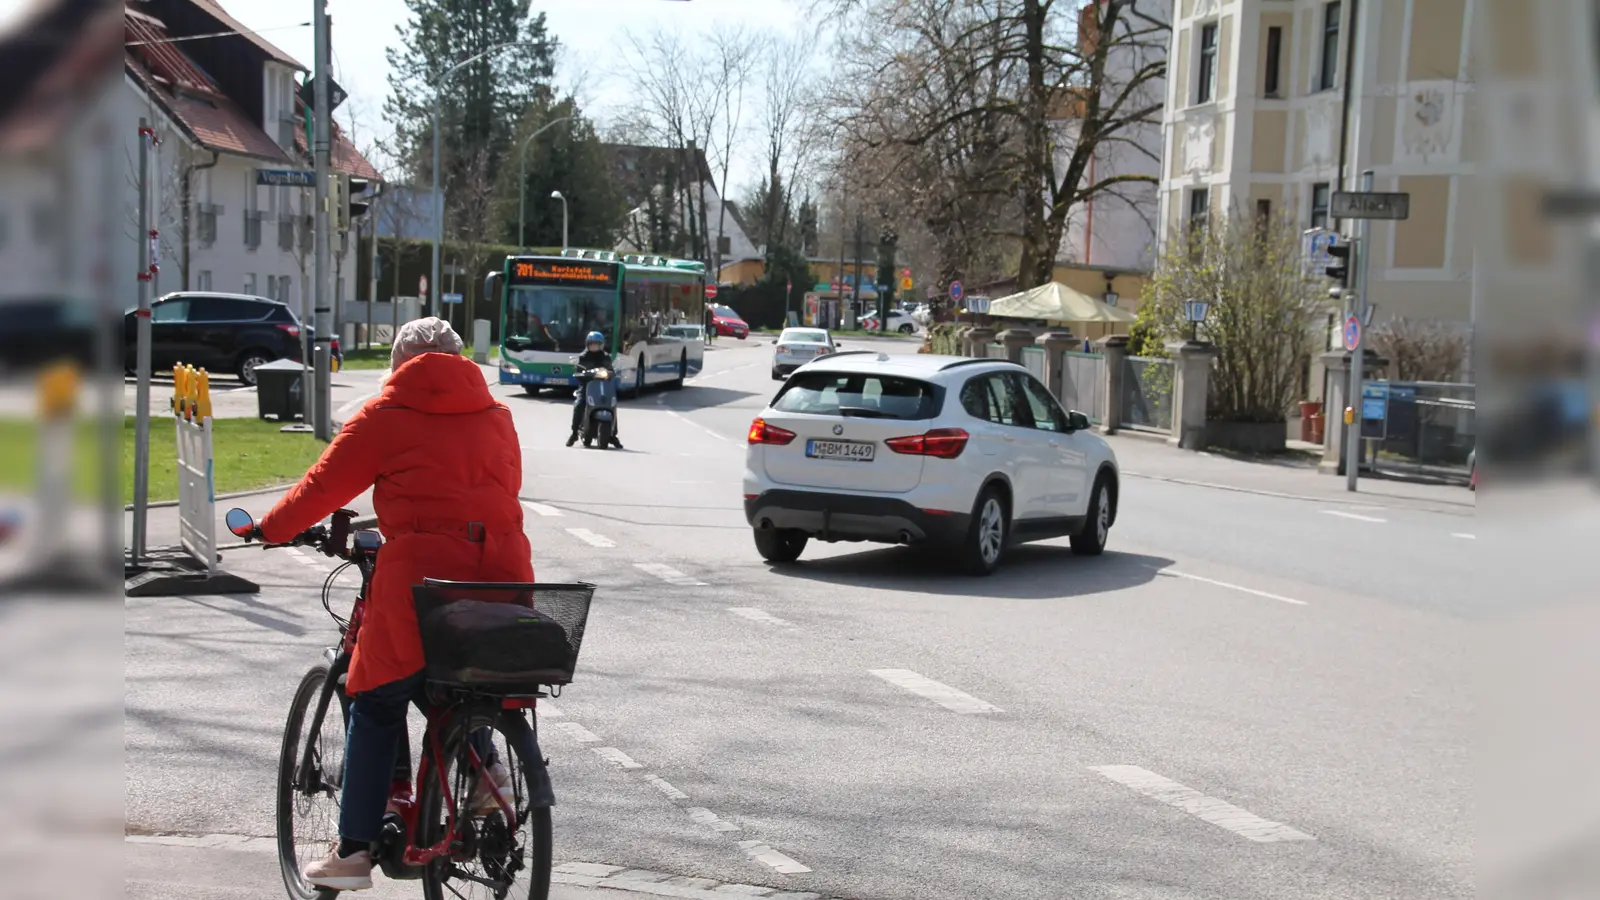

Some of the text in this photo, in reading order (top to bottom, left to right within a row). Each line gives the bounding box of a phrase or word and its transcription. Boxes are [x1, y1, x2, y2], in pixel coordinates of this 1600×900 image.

[1348, 195, 1393, 212] Allach
[517, 263, 592, 277] 701 Karlsfeld
[289, 377, 301, 400] 4
[844, 444, 872, 457] 1449
